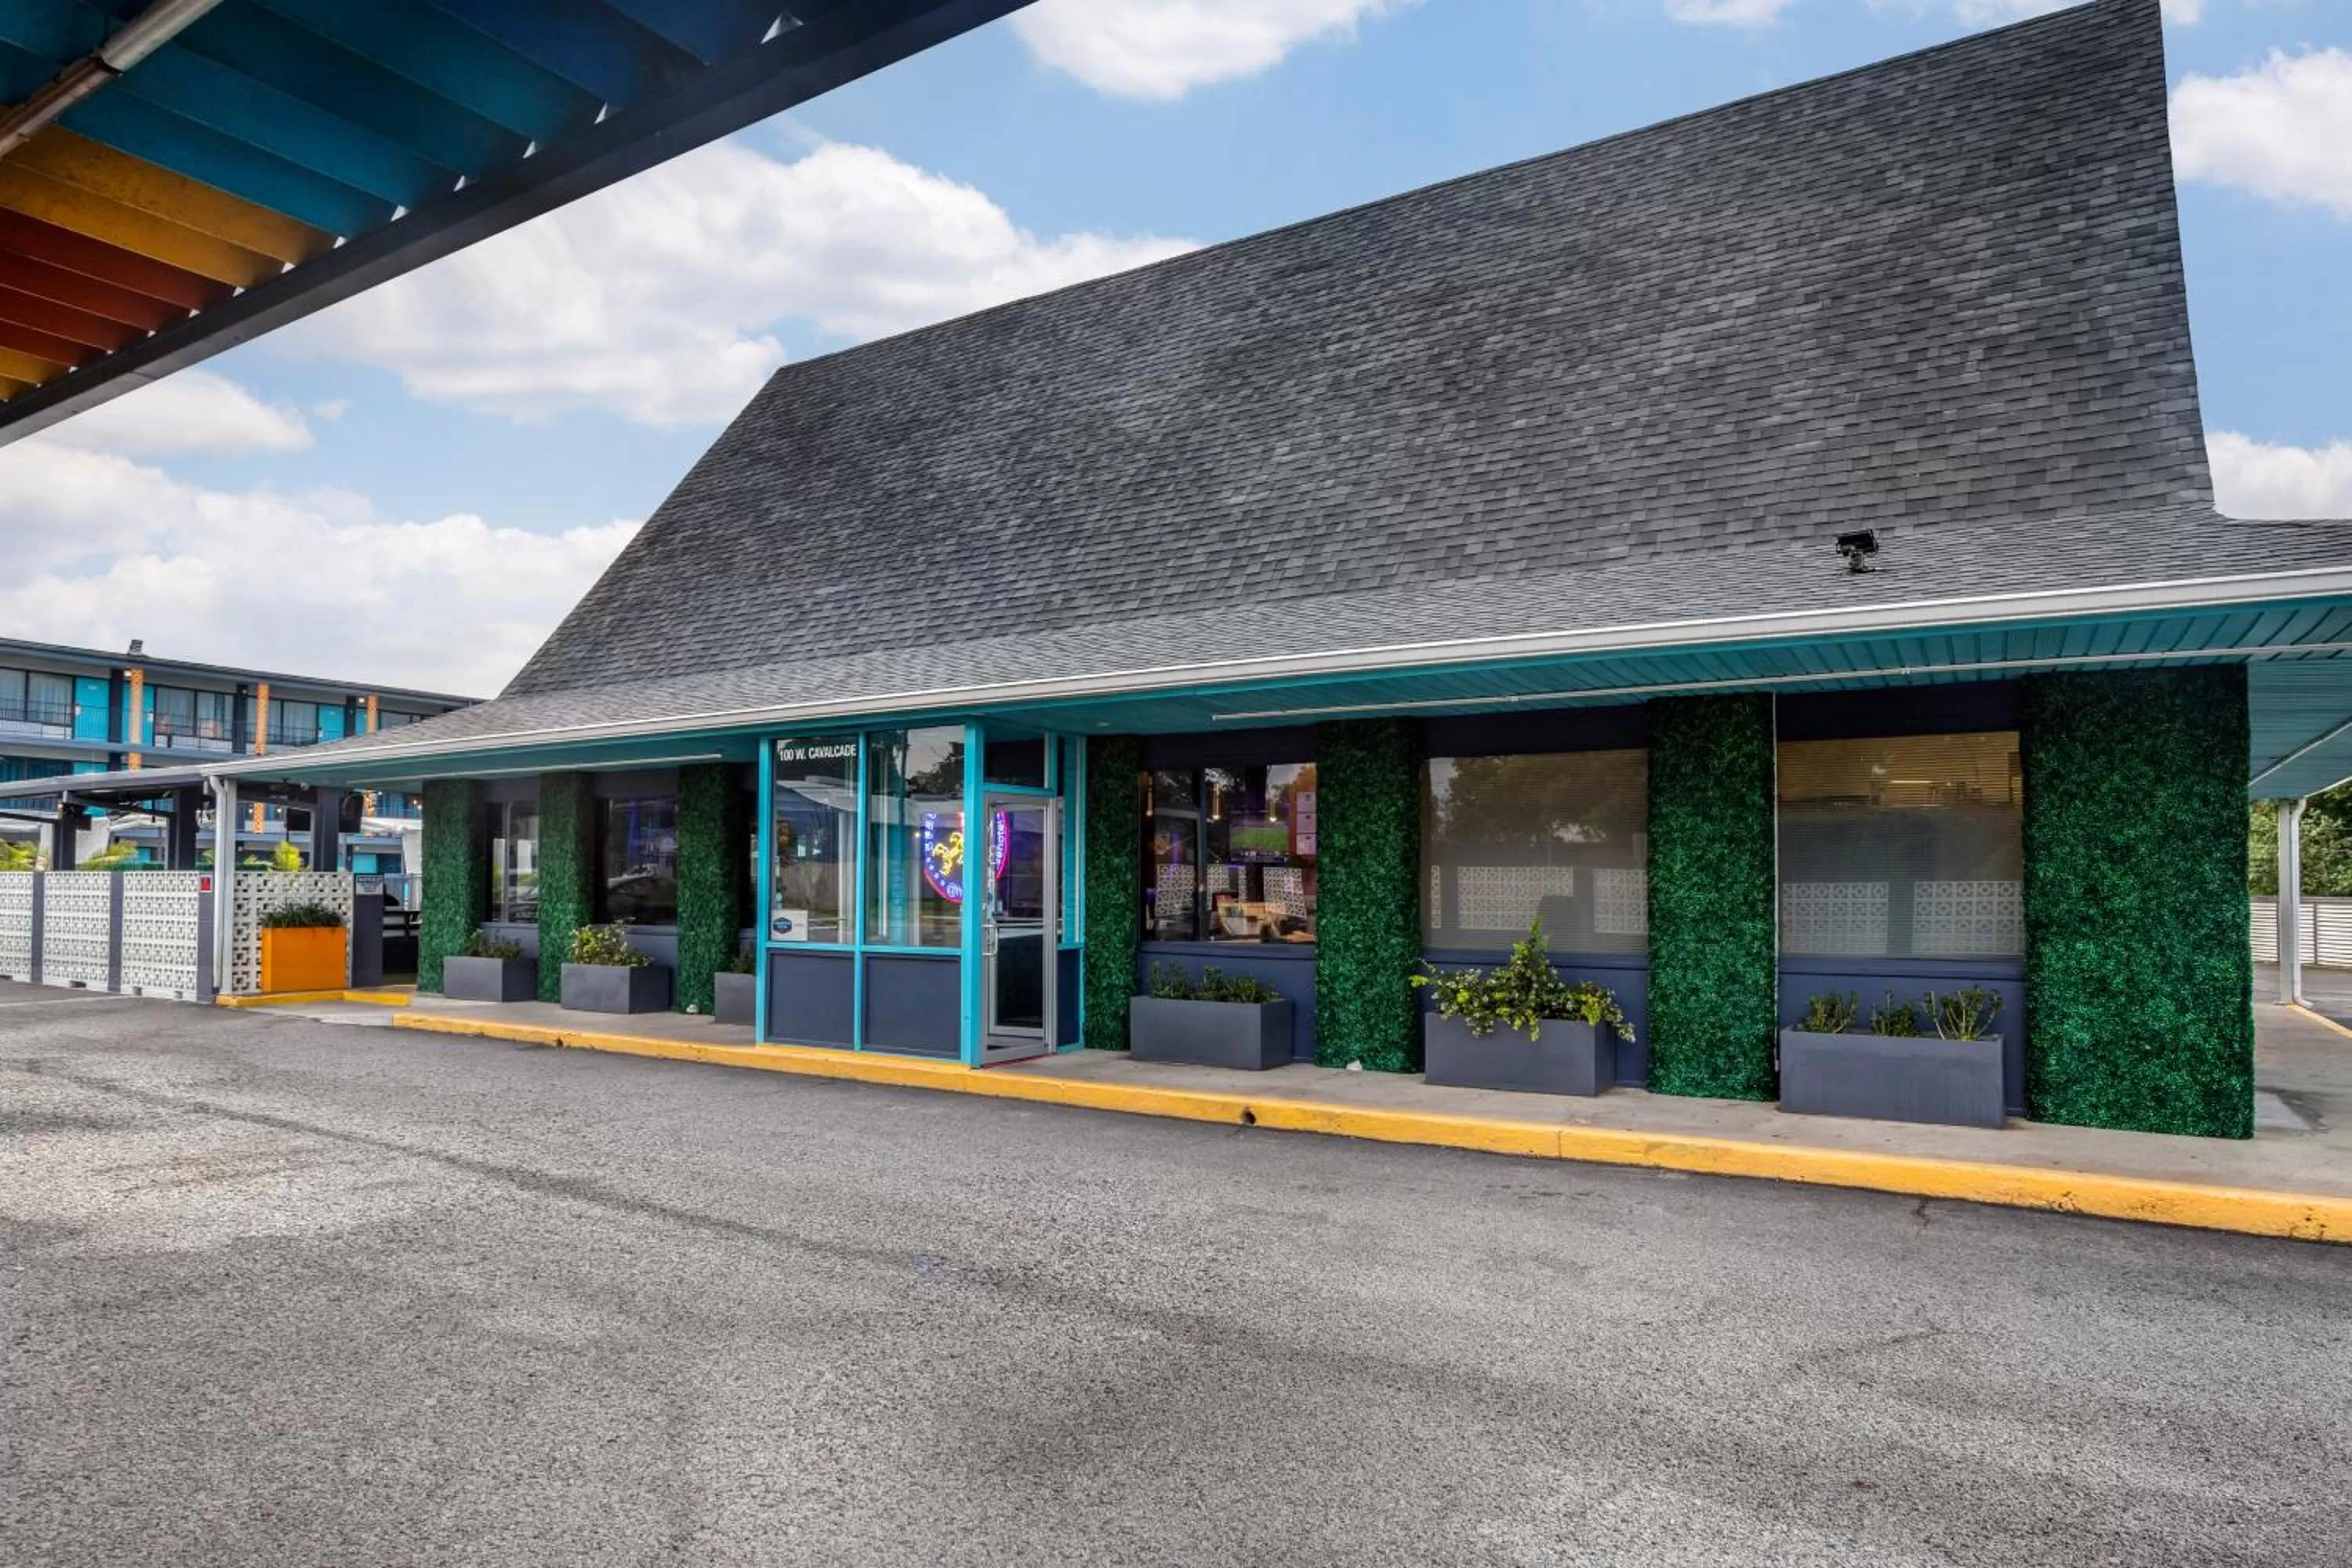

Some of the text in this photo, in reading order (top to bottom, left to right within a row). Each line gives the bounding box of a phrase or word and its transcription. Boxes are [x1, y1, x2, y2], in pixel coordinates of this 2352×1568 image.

[779, 744, 856, 761] 100 W. CAVALCADE
